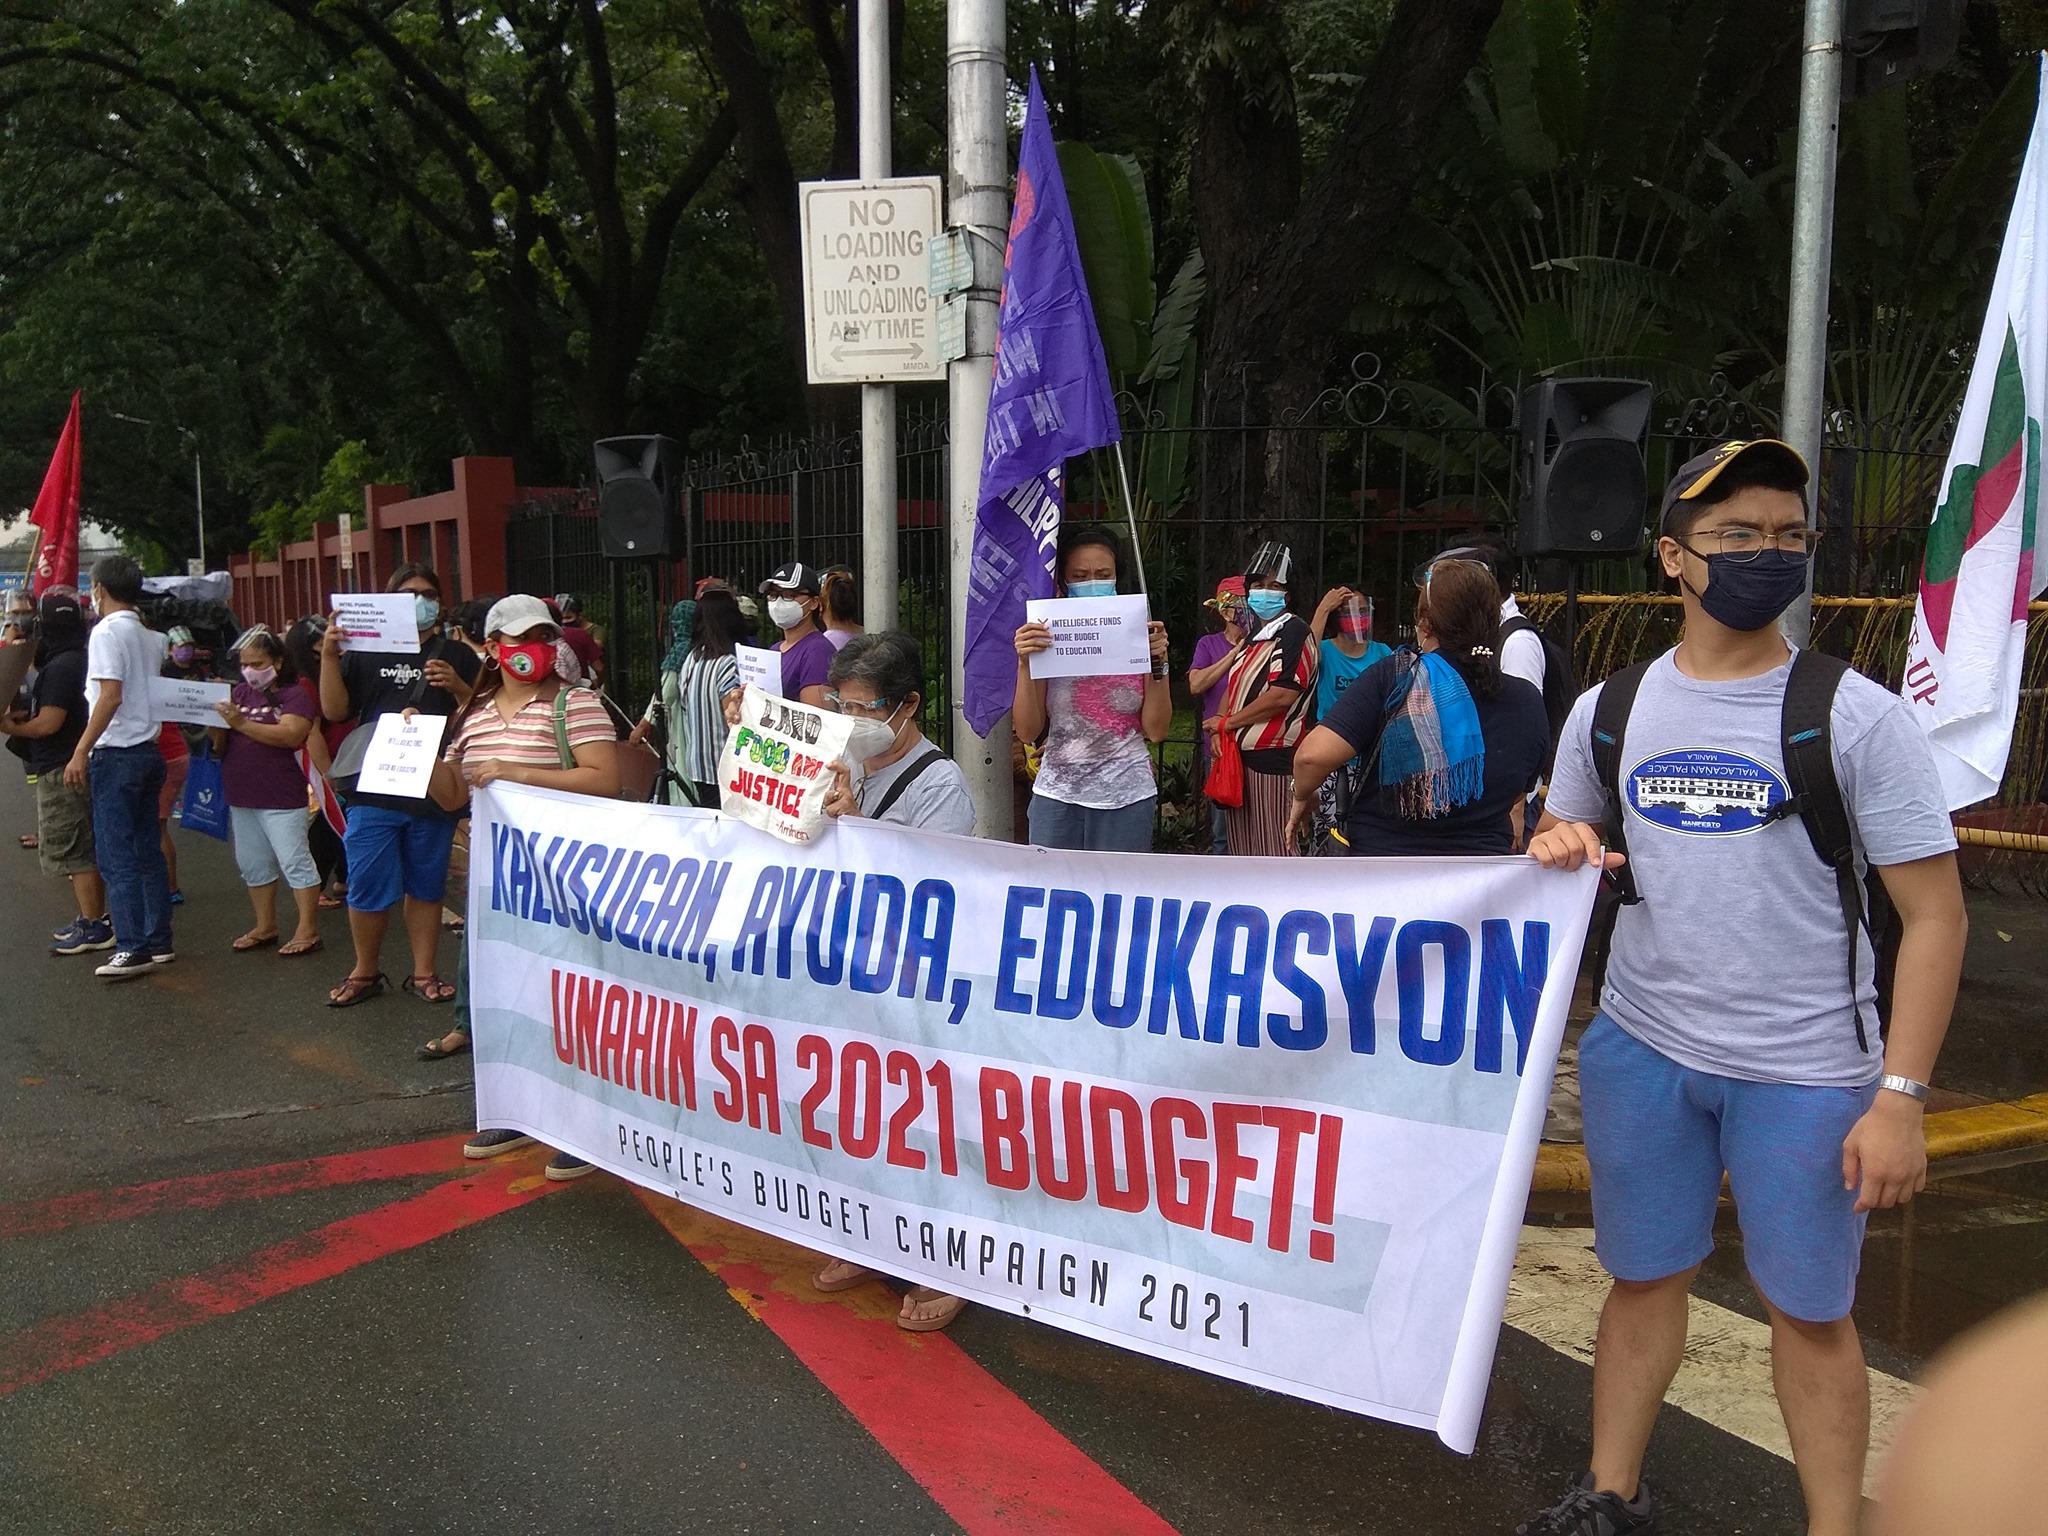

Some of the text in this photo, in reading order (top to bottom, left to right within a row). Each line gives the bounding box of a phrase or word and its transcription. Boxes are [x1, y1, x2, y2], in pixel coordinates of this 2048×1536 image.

[849, 198, 895, 226] NO
[823, 230, 924, 260] LOADING
[847, 264, 901, 284] AND
[824, 286, 928, 315] UNLOADING
[903, 362, 930, 371] MMDA
[1052, 616, 1122, 628] INTELLIGENCE FUNDS
[1054, 632, 1100, 642] MORE BUDGET
[1055, 646, 1102, 656] TO EDUCATION
[759, 699, 823, 745] LAND
[734, 726, 790, 774] FOOD
[1686, 753, 1718, 761] MANILA
[1647, 764, 1688, 773] PALACE
[730, 767, 806, 819] JUSTICE
[1681, 820, 1721, 828] MANIFESTO
[490, 821, 1551, 1077] KALUSUGAN, AYUDA, EDUKASYON
[551, 968, 1344, 1264] UNAHIN SA 2021 BUDGET!
[618, 1123, 1250, 1348] PEOPLE'S BUDGET CAMPAIGN 2021
